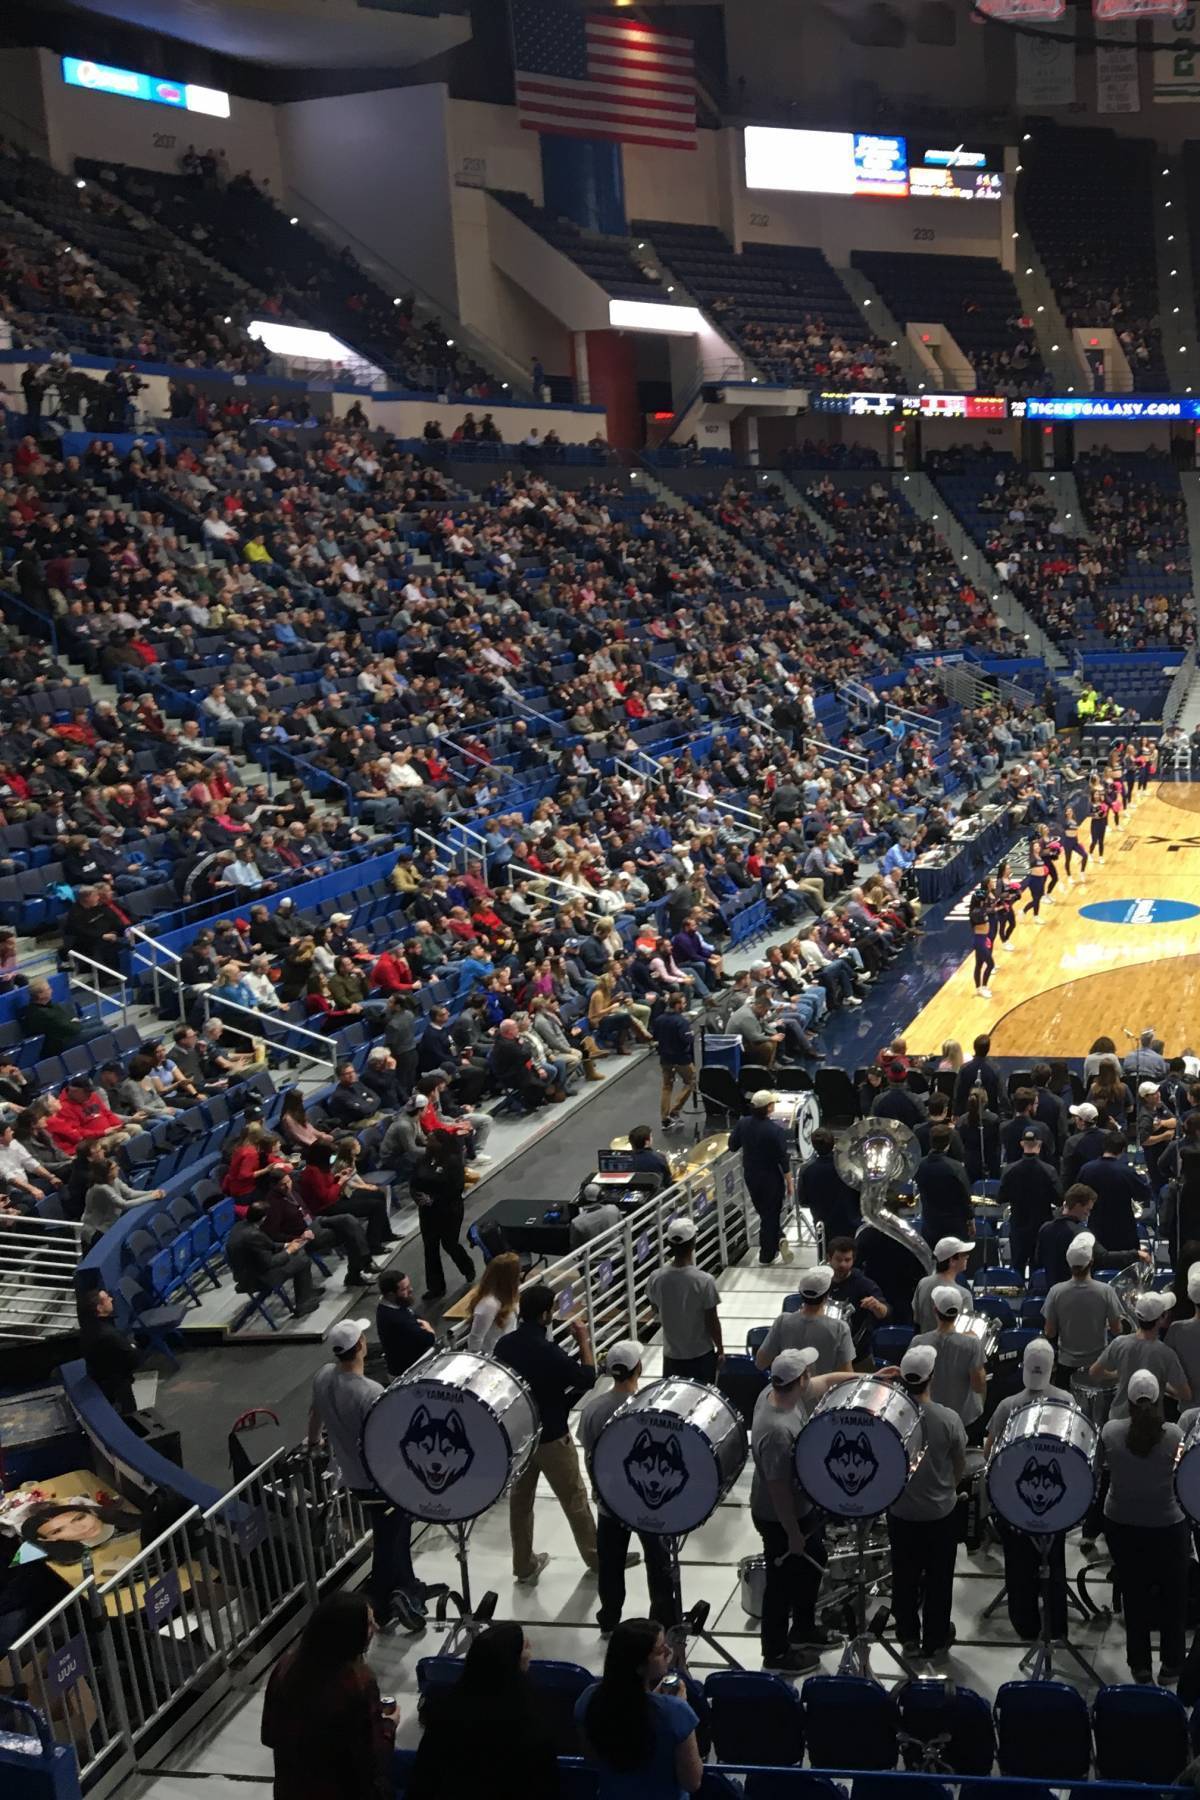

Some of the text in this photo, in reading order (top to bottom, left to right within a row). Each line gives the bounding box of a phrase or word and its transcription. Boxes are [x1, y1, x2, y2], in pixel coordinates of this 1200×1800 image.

[1030, 402, 1181, 416] TICKETGALAXY.COM
[426, 1389, 464, 1404] YAMAHA
[649, 1417, 683, 1432] YAMAHA
[839, 1415, 874, 1427] YAMAHA
[1033, 1444, 1066, 1454] YAMAHA
[57, 1659, 77, 1682] UUU
